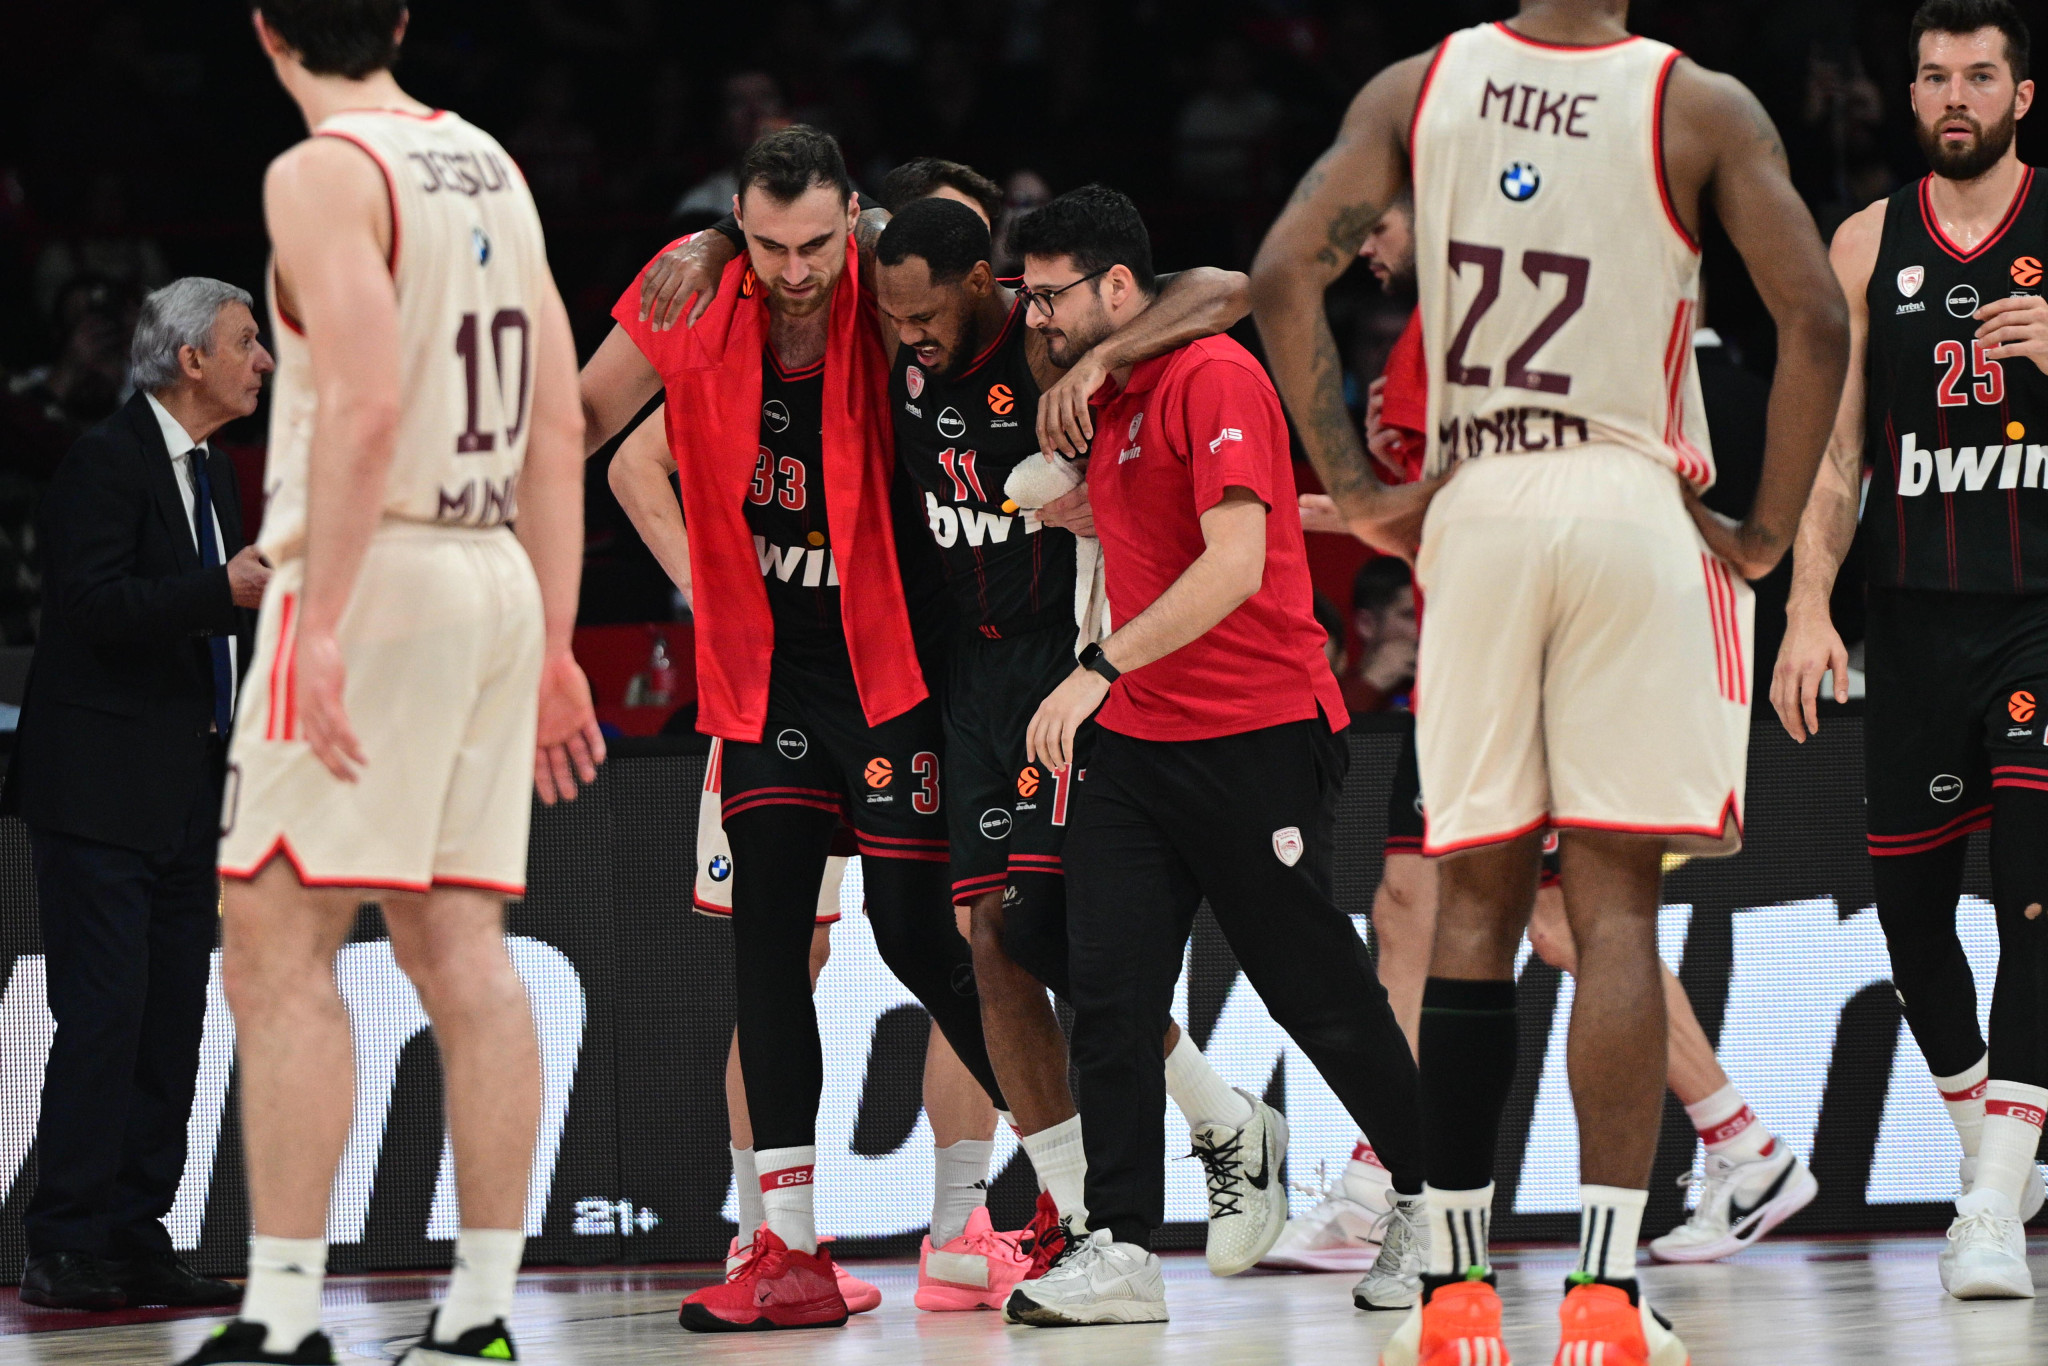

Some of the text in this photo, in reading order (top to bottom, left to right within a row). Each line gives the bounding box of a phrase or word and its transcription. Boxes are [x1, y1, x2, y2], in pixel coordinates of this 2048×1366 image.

[1479, 78, 1598, 138] MIKE
[1446, 239, 1591, 396] 22
[1948, 296, 1978, 305] GSA
[455, 308, 530, 453] 10
[1934, 339, 2005, 407] 25
[940, 417, 964, 426] GSA
[1118, 442, 1142, 465] bwin
[748, 445, 806, 511] 33
[938, 447, 987, 503] 11
[752, 530, 840, 587] wi
[779, 739, 806, 747] GSA
[982, 818, 1010, 829] GSA
[2006, 1105, 2043, 1126] GS
[573, 1196, 660, 1236] 21+
[1396, 1200, 1414, 1208] NIKE
